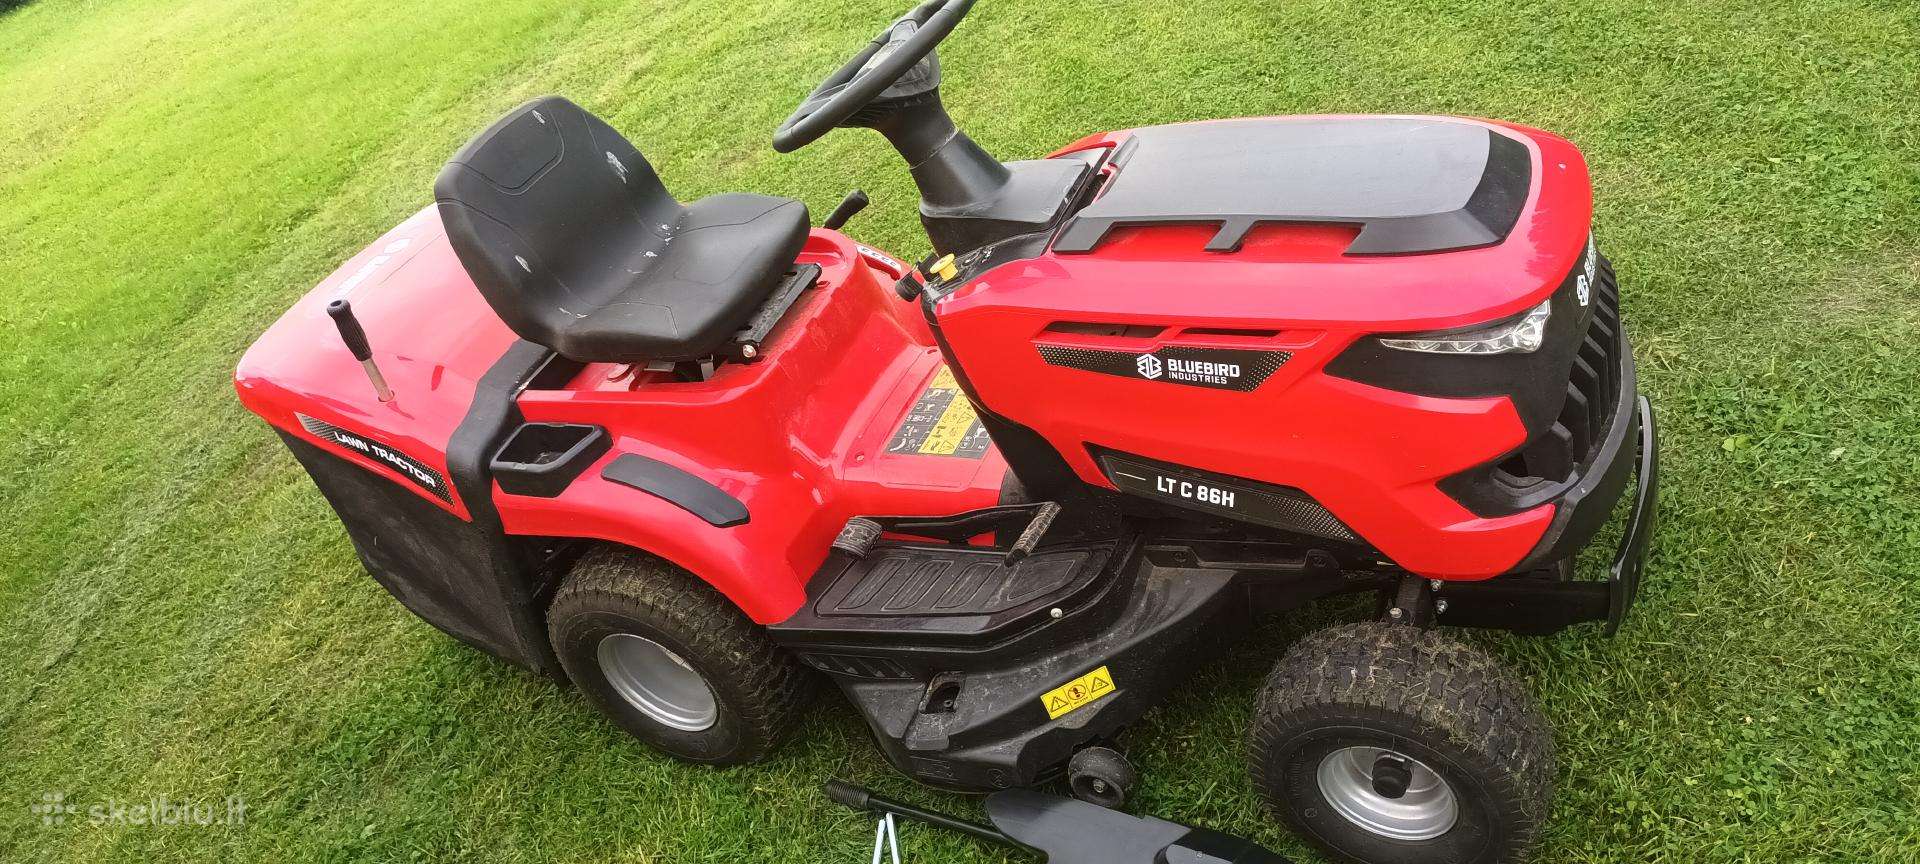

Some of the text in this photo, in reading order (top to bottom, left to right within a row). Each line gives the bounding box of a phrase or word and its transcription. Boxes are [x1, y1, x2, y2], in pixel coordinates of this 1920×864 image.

[1167, 358, 1240, 378] BLUEBIRD
[1168, 371, 1228, 385] INDUSTRIES
[334, 431, 436, 487] LAWN TRACTOR
[1157, 475, 1235, 508] LT C 86H
